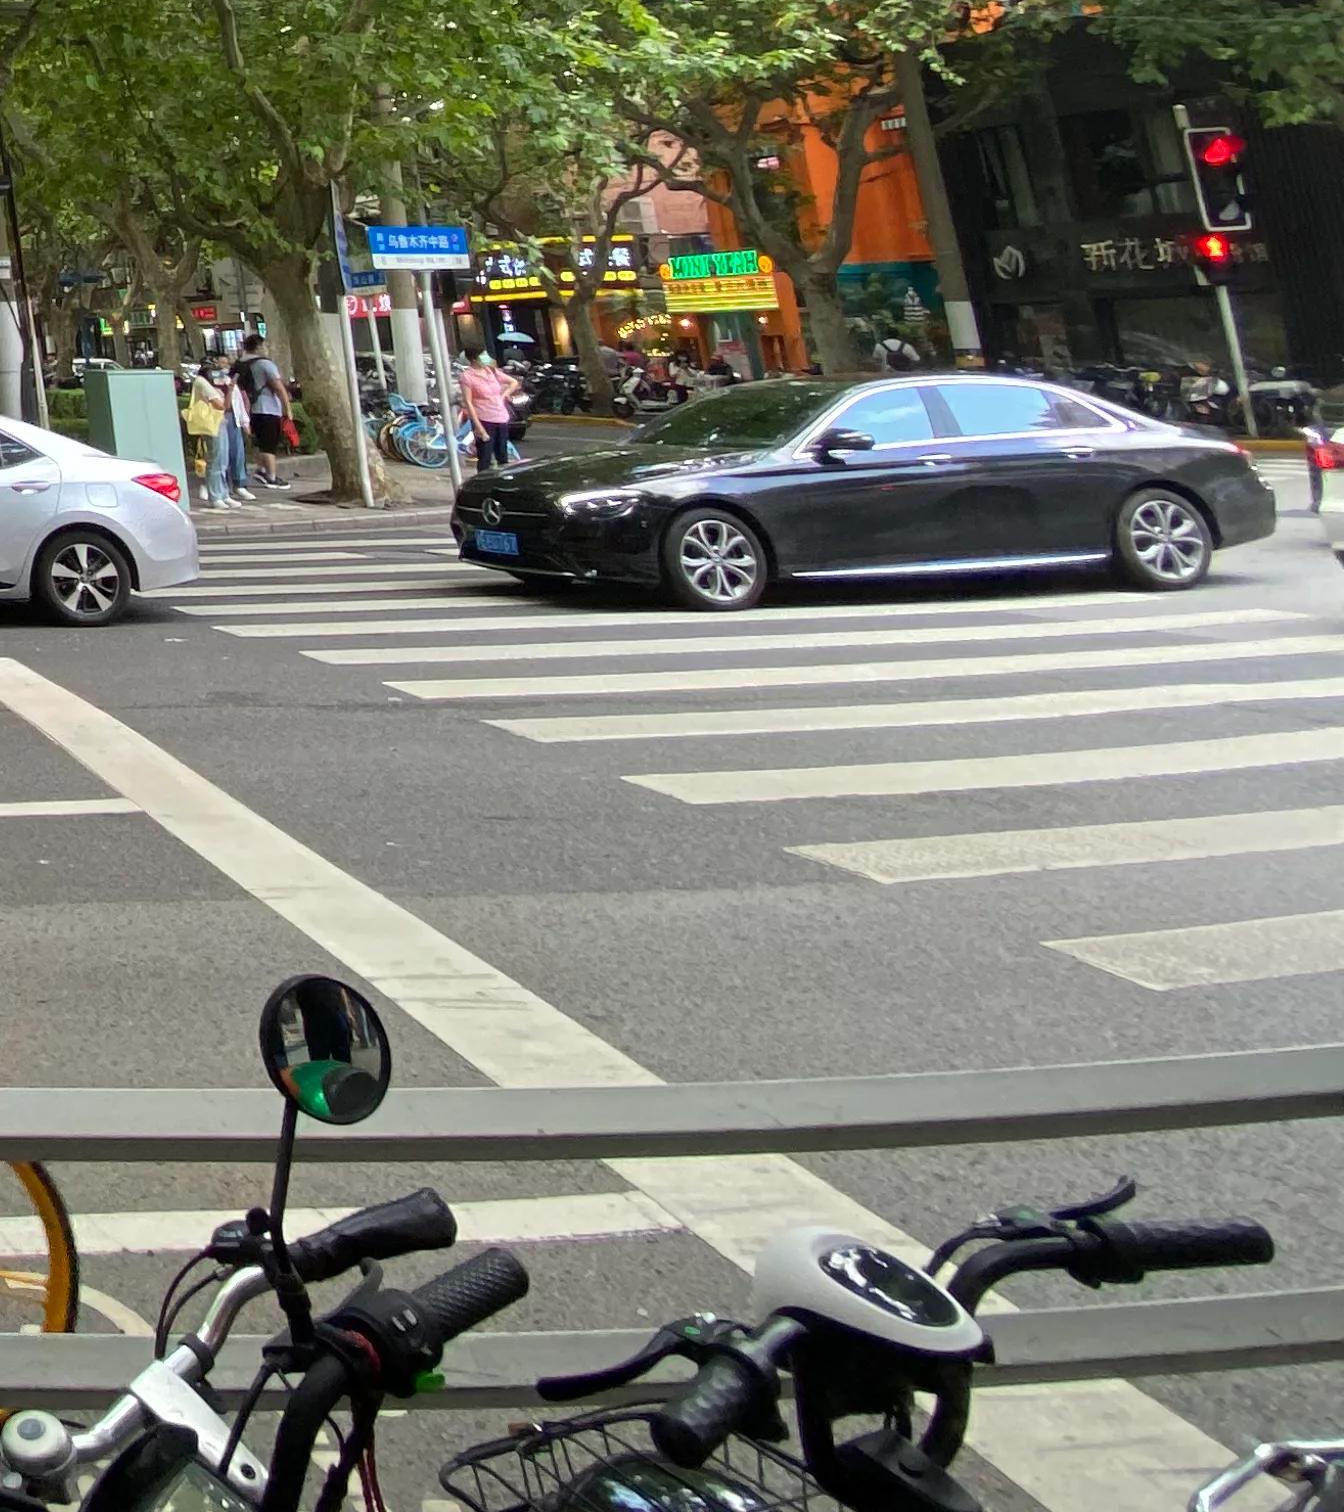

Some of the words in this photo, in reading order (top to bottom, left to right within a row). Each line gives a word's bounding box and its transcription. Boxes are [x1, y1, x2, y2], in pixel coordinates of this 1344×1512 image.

[387, 234, 450, 249] 乌鲁木齐中路
